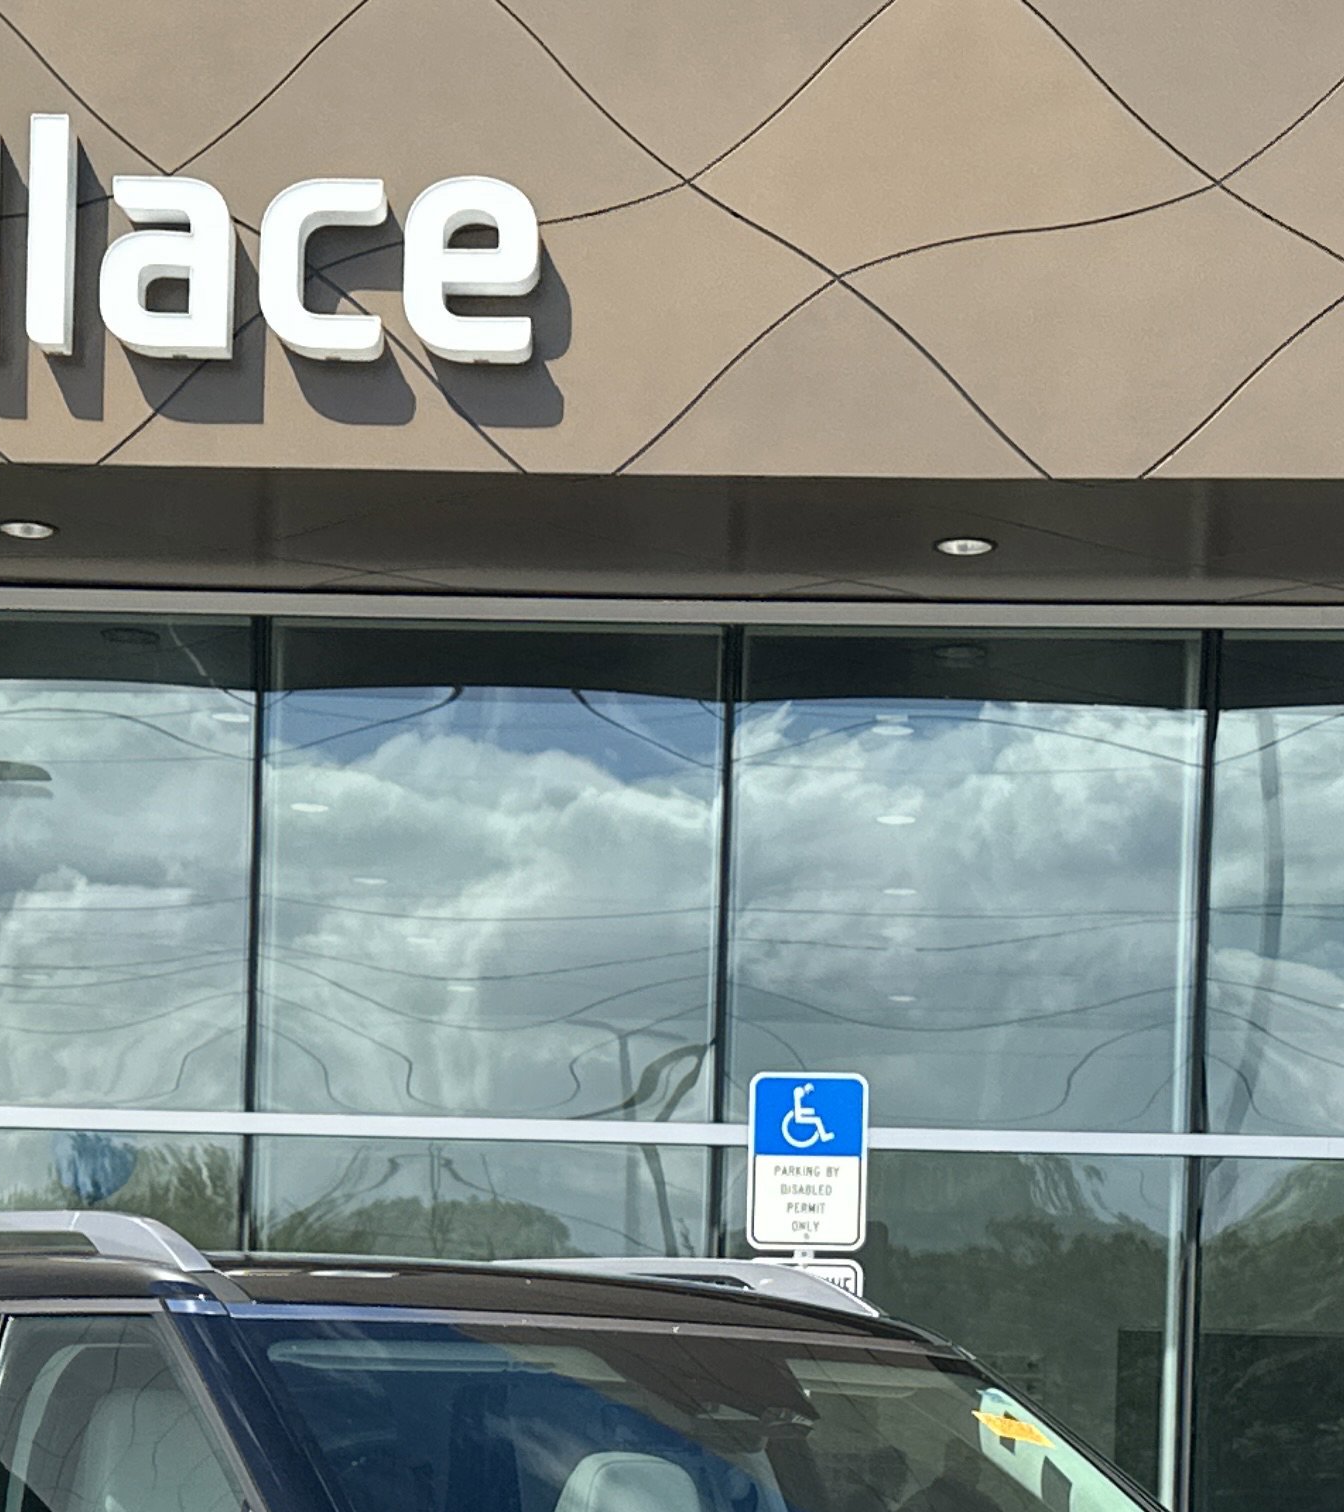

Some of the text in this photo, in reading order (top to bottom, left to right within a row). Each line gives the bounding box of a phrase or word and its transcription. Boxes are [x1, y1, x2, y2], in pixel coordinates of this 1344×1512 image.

[773, 1165, 840, 1178] PARKING BY
[780, 1183, 833, 1196] DISABLED
[786, 1202, 826, 1214] PERMIT
[791, 1220, 820, 1233] ONLY
